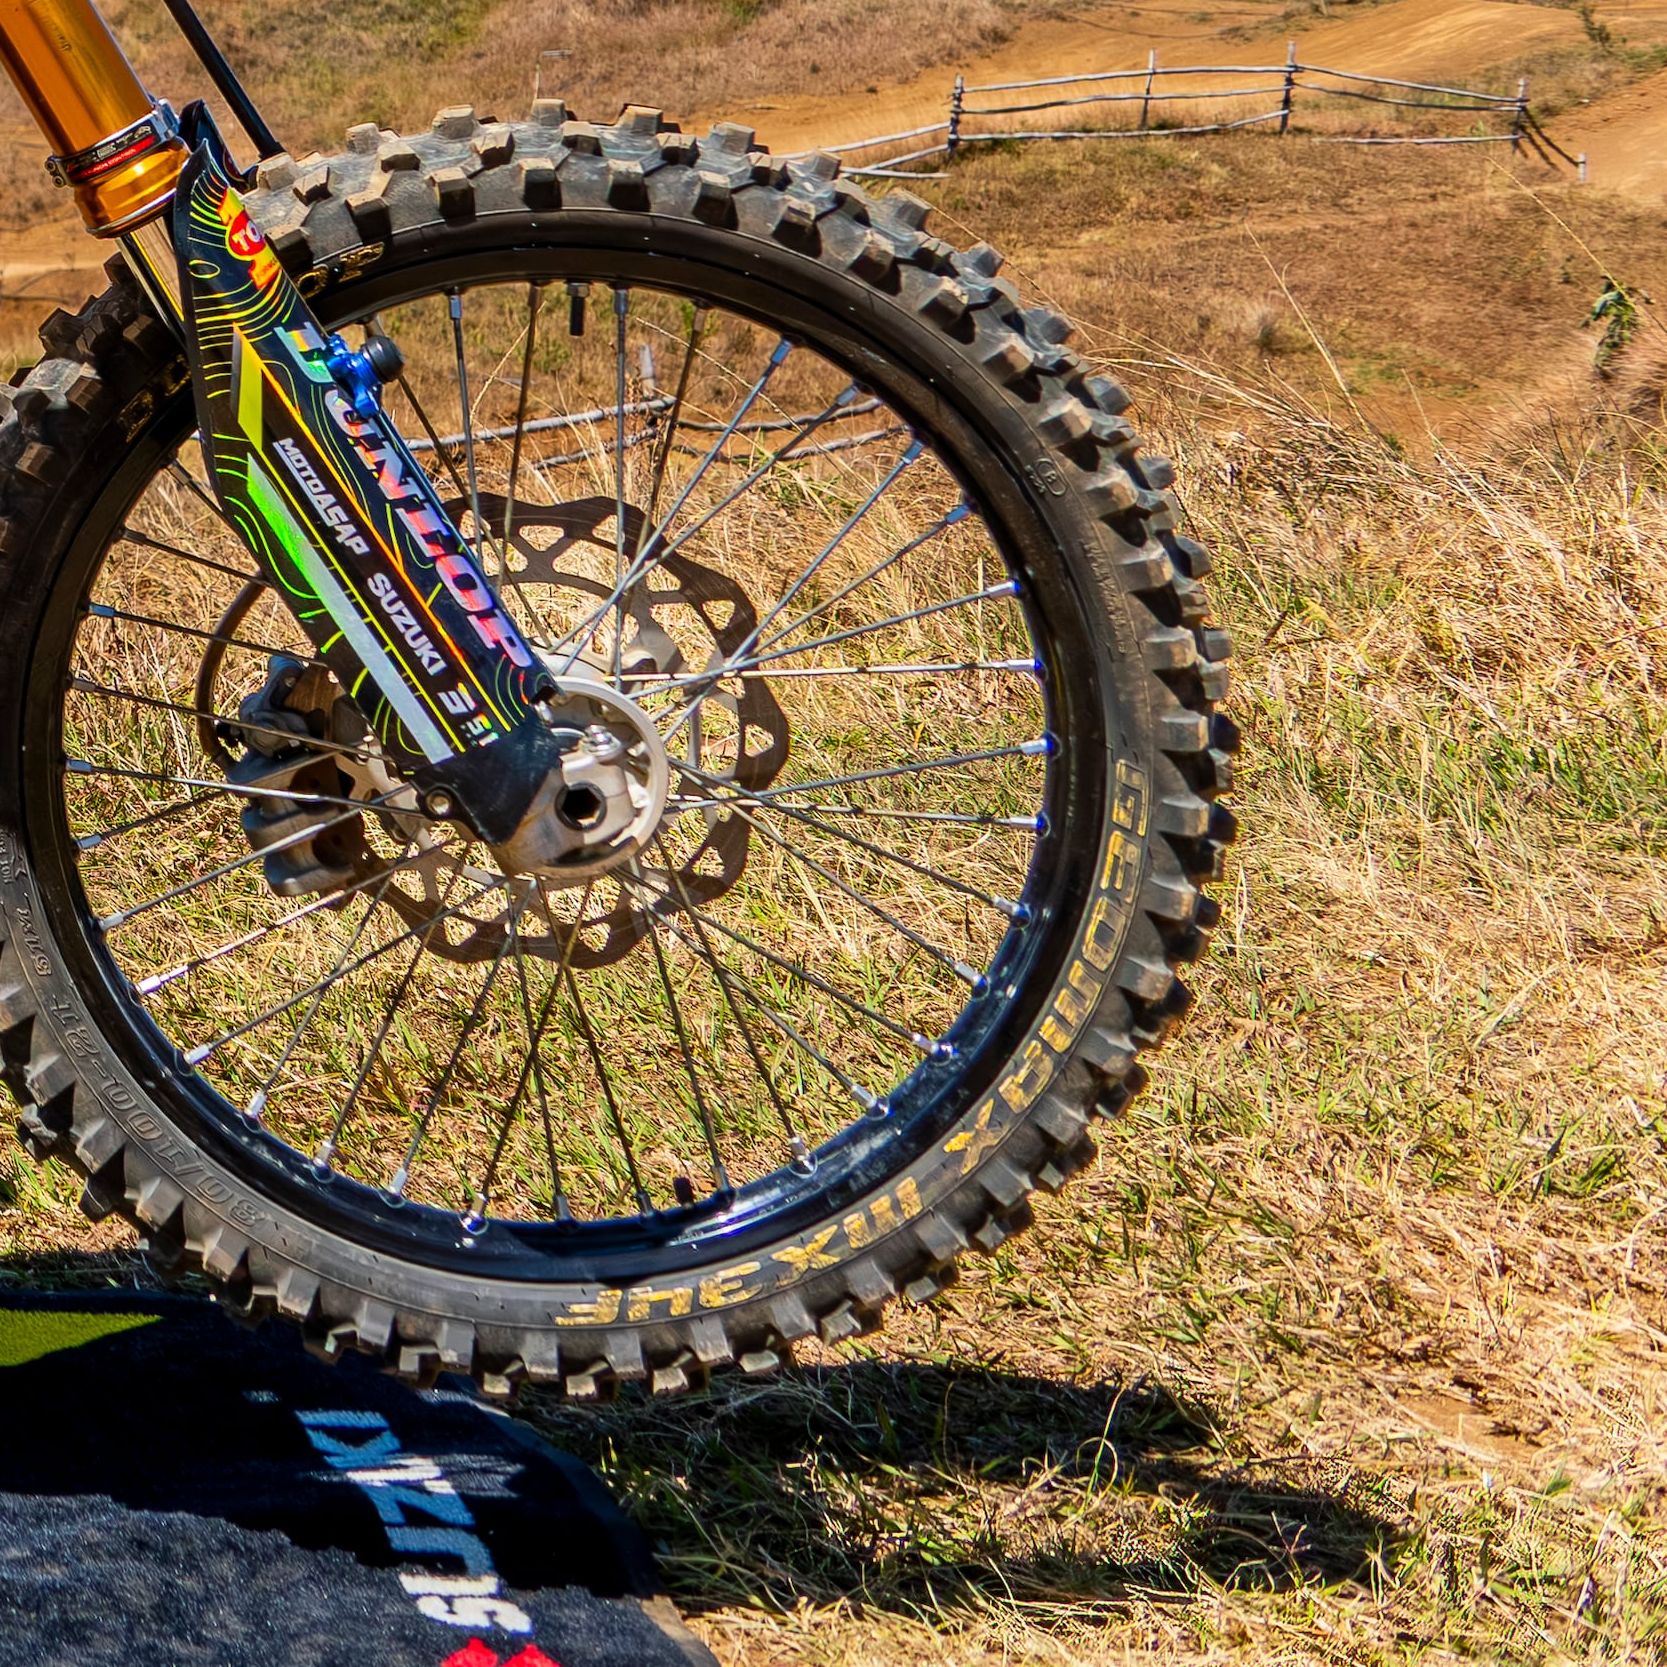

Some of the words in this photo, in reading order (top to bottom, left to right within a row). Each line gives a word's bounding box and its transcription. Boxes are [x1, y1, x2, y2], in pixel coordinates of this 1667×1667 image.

[231, 219, 264, 252] TO
[272, 437, 370, 557] MOTOASAP
[366, 571, 448, 678] SUZUKI
